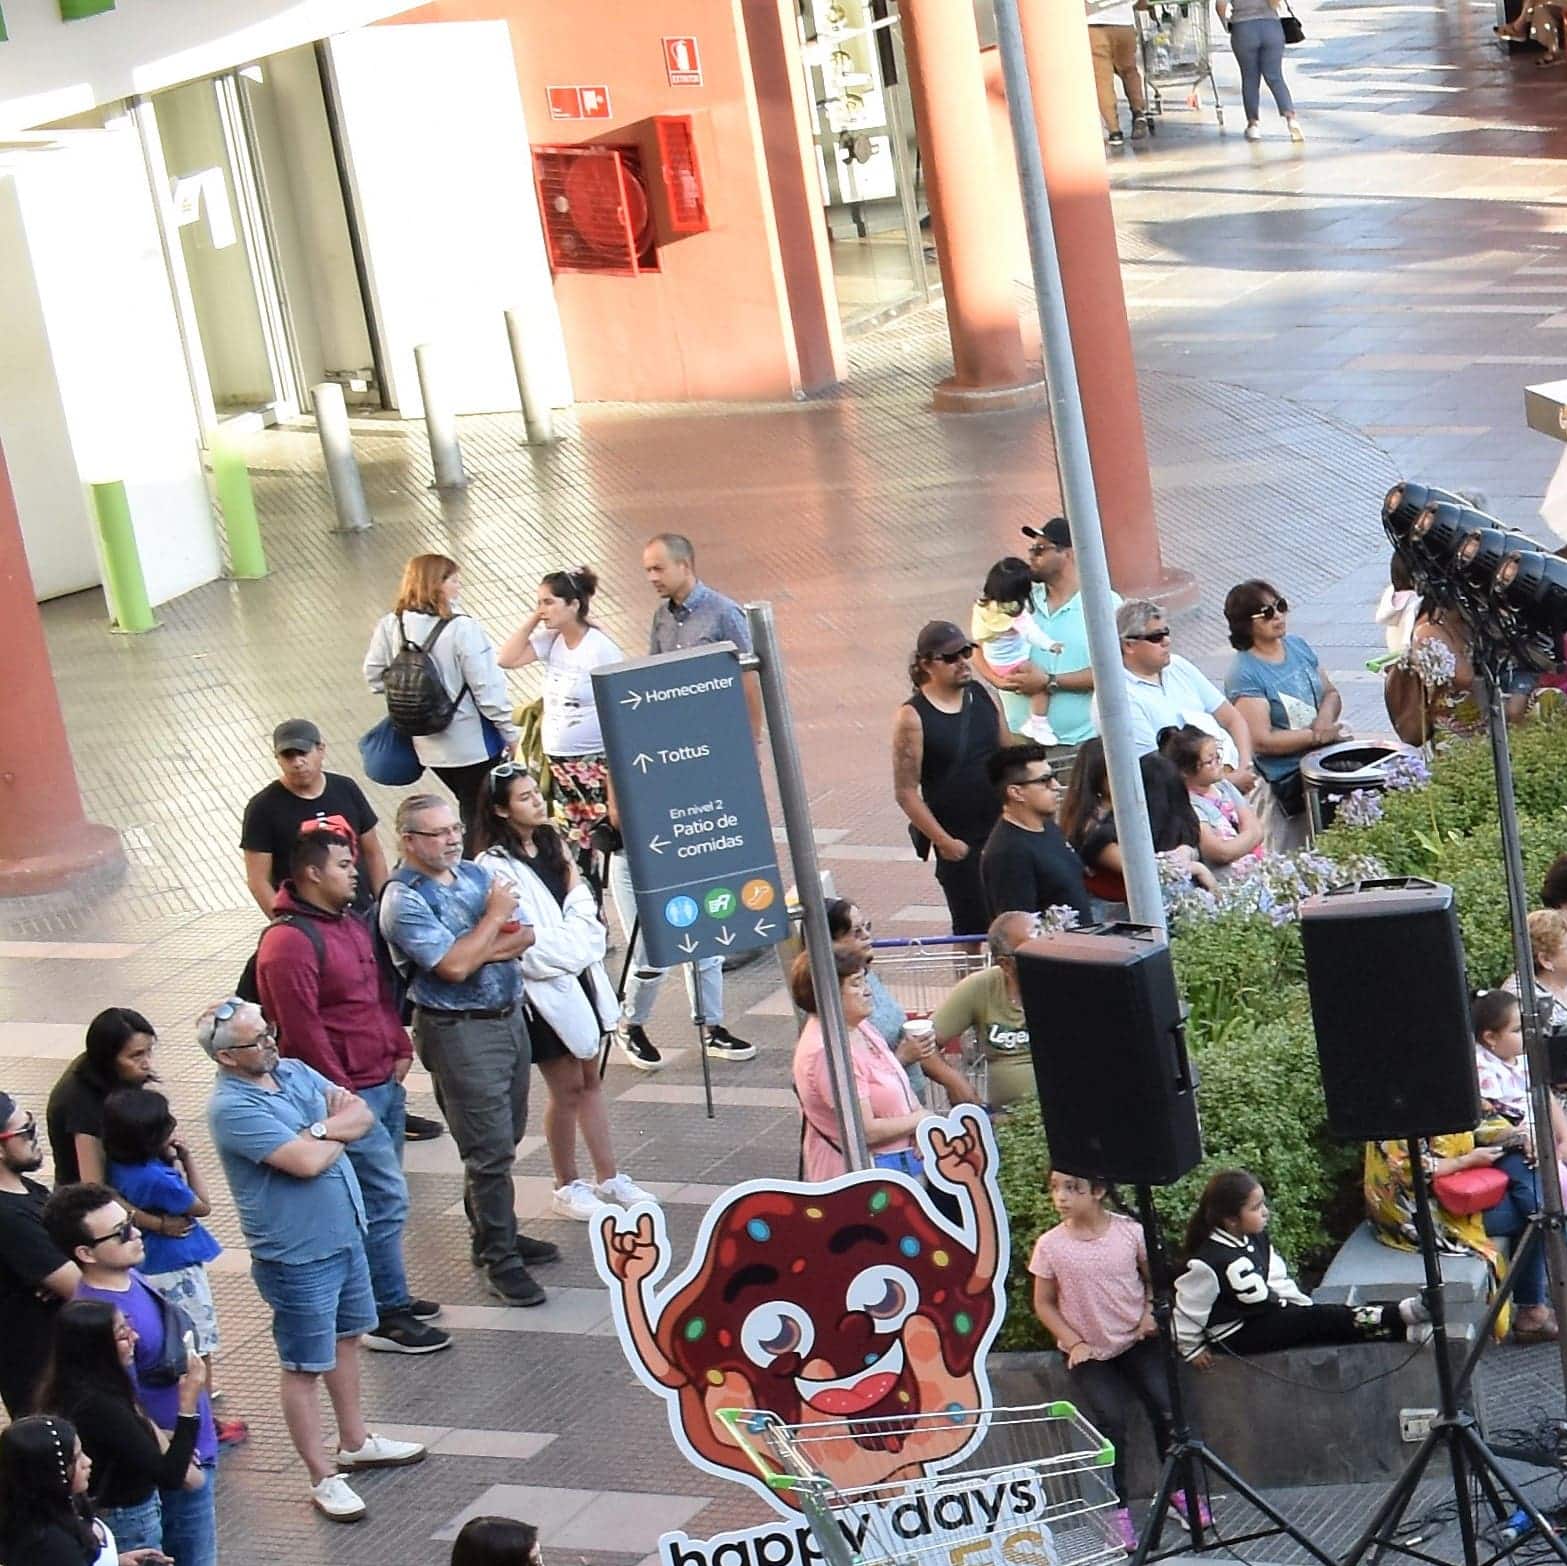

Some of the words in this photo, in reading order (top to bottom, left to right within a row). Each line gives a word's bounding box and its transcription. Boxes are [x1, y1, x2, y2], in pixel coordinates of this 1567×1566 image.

[645, 676, 734, 704] Homecenter
[657, 743, 710, 764] Tottus
[670, 808, 687, 819] En
[688, 801, 714, 816] nivel
[715, 800, 723, 810] 2
[673, 818, 713, 837] Patio
[716, 815, 738, 830] de
[678, 834, 744, 857] comidas
[1226, 1256, 1268, 1304] S
[891, 1478, 1042, 1539] days
